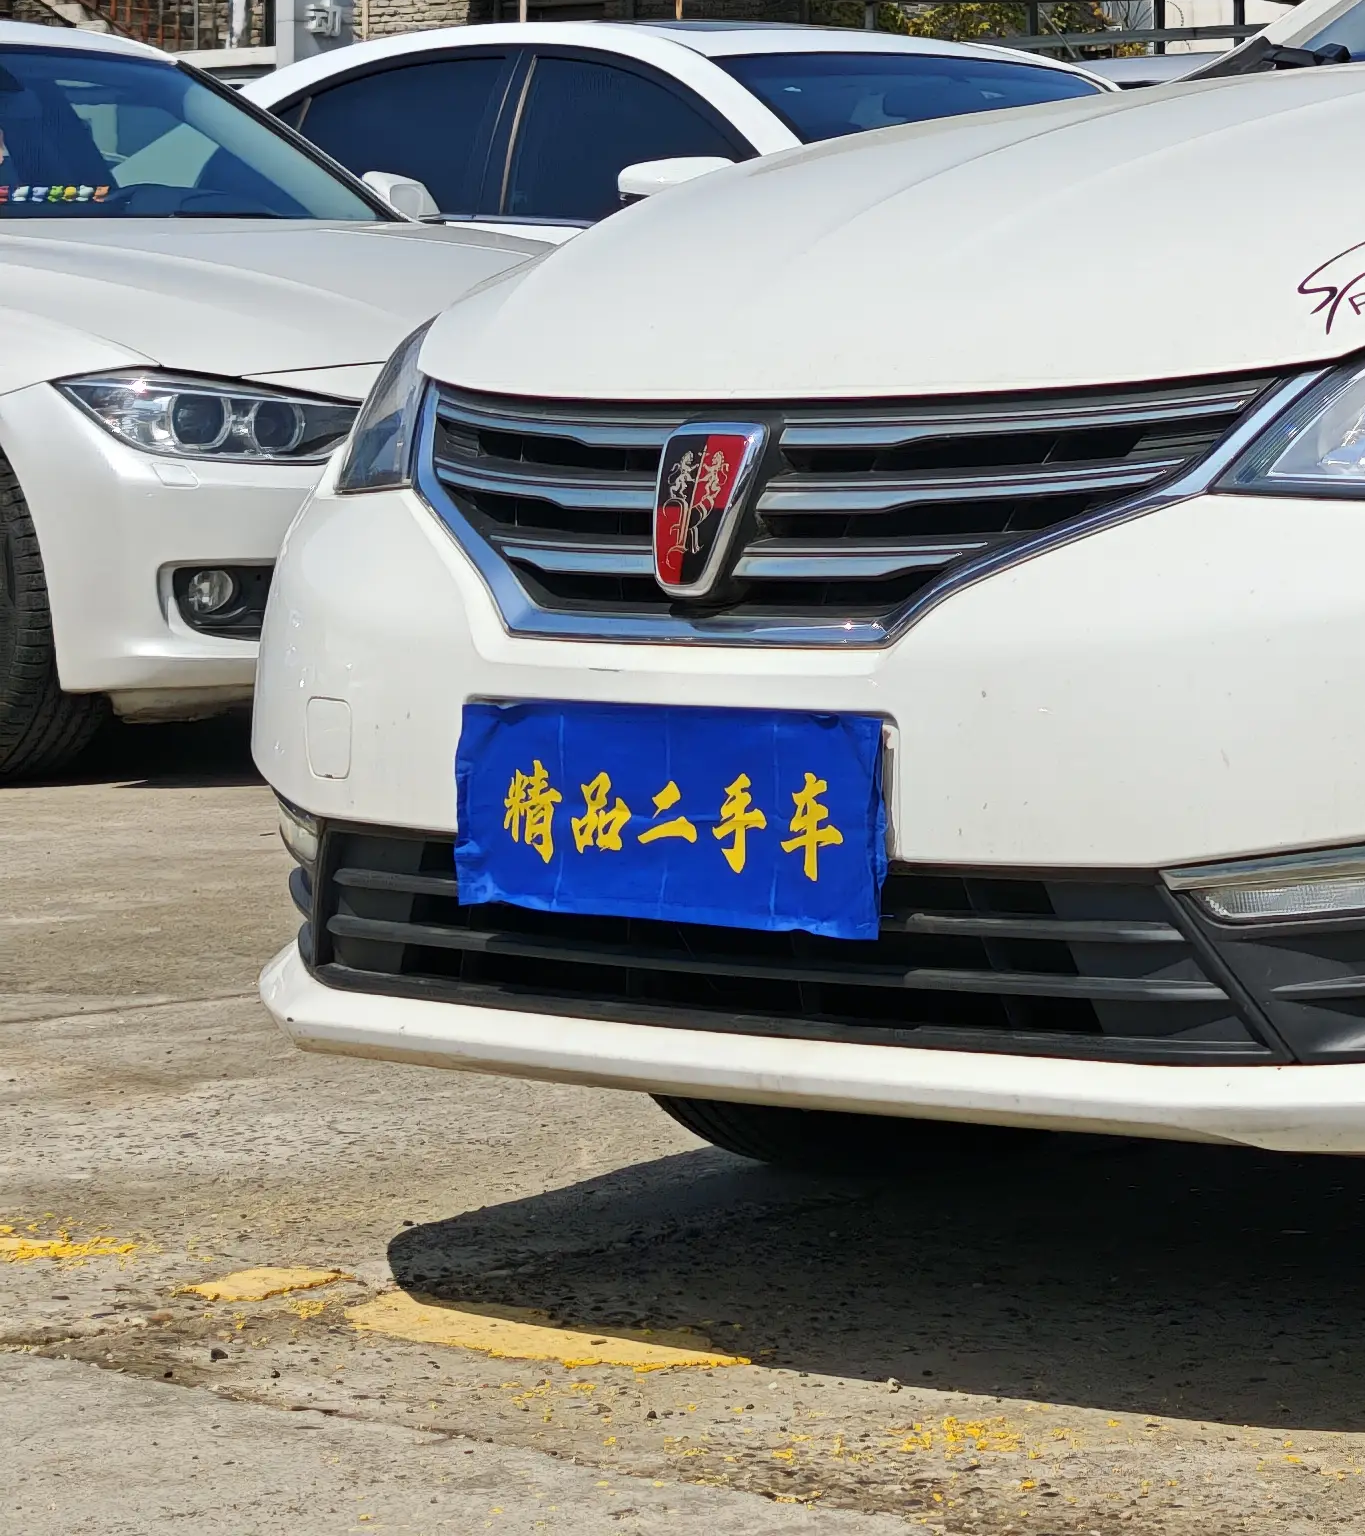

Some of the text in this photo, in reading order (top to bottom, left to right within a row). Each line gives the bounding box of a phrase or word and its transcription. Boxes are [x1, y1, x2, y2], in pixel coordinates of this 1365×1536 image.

[503, 759, 844, 882] 精品二手车
